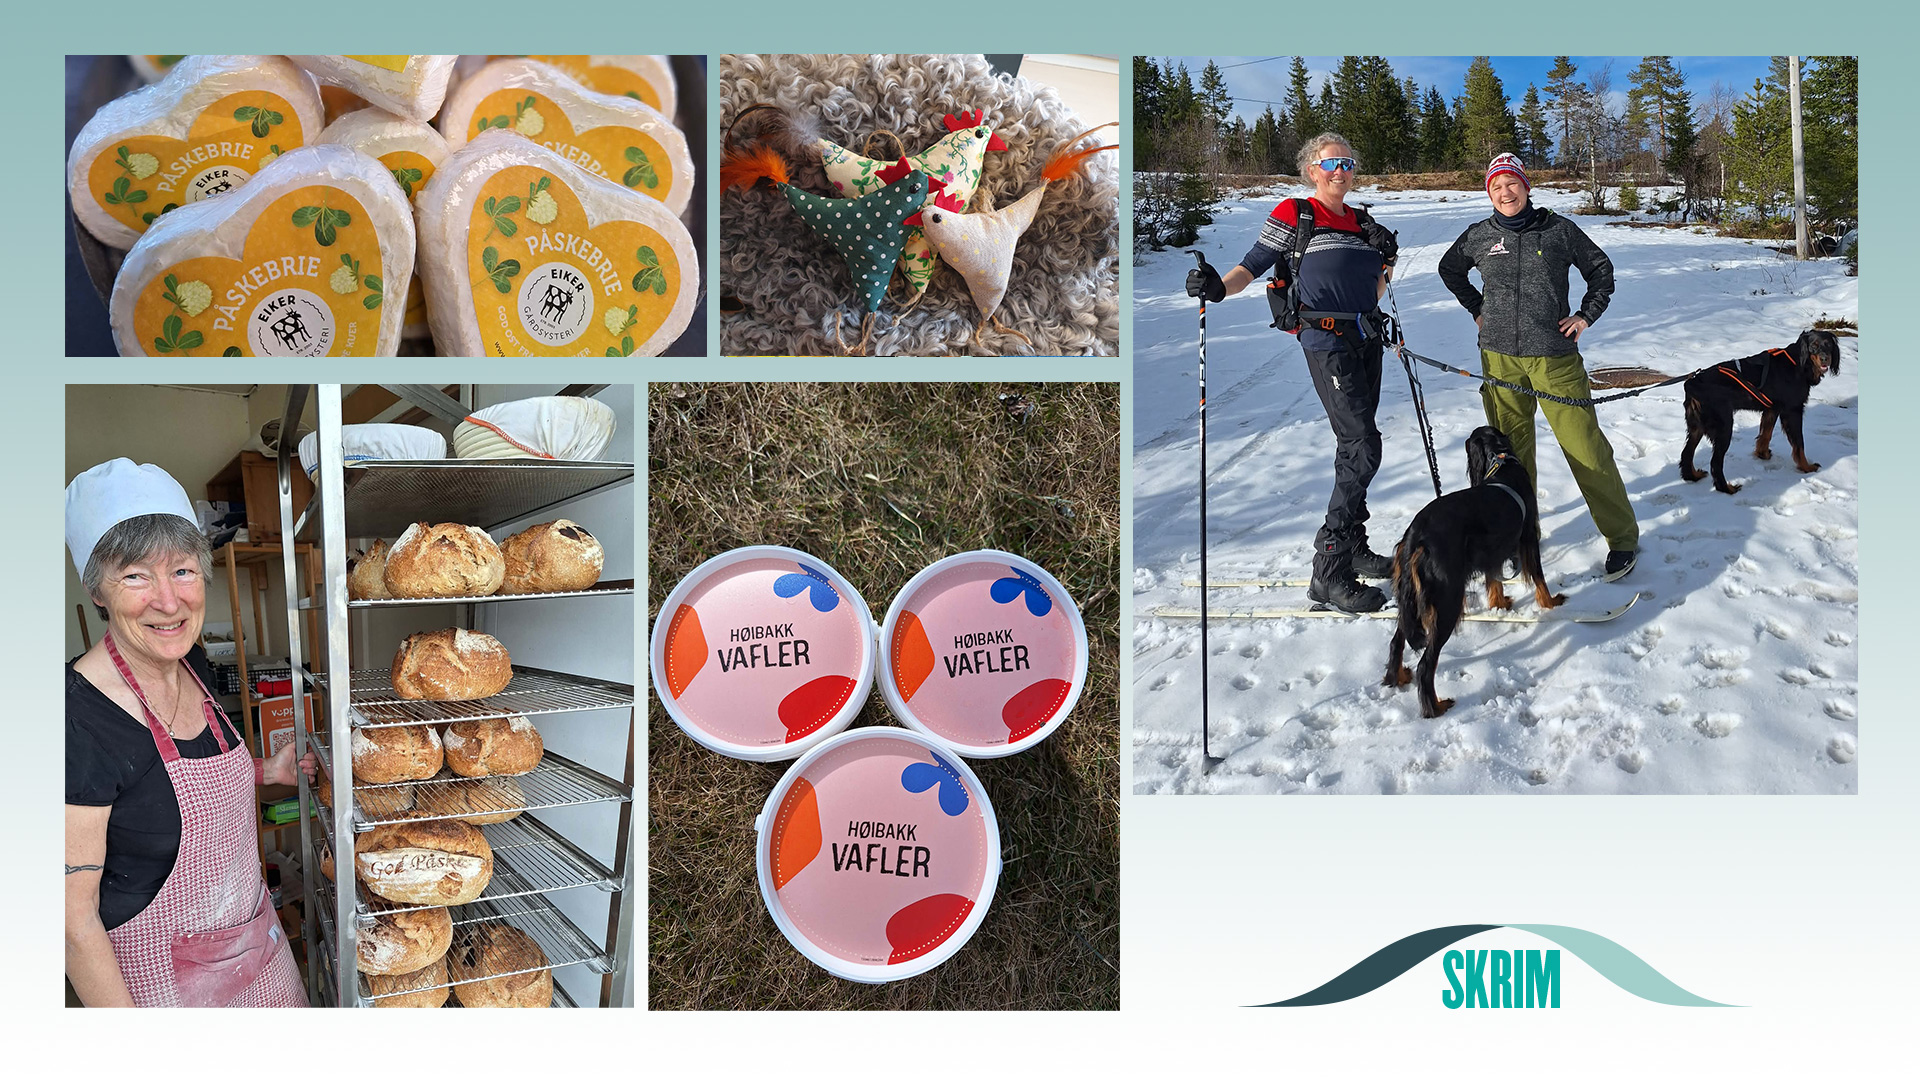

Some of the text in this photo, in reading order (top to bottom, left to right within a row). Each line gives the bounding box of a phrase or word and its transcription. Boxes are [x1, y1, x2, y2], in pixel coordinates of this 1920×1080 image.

[157, 142, 254, 192] PÅSKEBRIE
[531, 139, 610, 181] SKEBR
[196, 170, 229, 188] EIKER
[525, 228, 623, 296] PÅSKEBRIE
[213, 256, 321, 331] PÅSKEBRIE
[551, 269, 584, 292] EIKER
[258, 295, 296, 322] EIKER
[498, 305, 508, 328] GOD
[505, 329, 520, 347] OST
[730, 623, 794, 642] HØIBAKK
[954, 629, 1014, 649] HØIBAKK
[718, 640, 810, 672] VAFLER
[943, 645, 1030, 678] VAFLER
[271, 706, 294, 717] vipp
[848, 820, 917, 841] HØIBAKK
[371, 855, 408, 880] God
[832, 843, 930, 877] VAFLER
